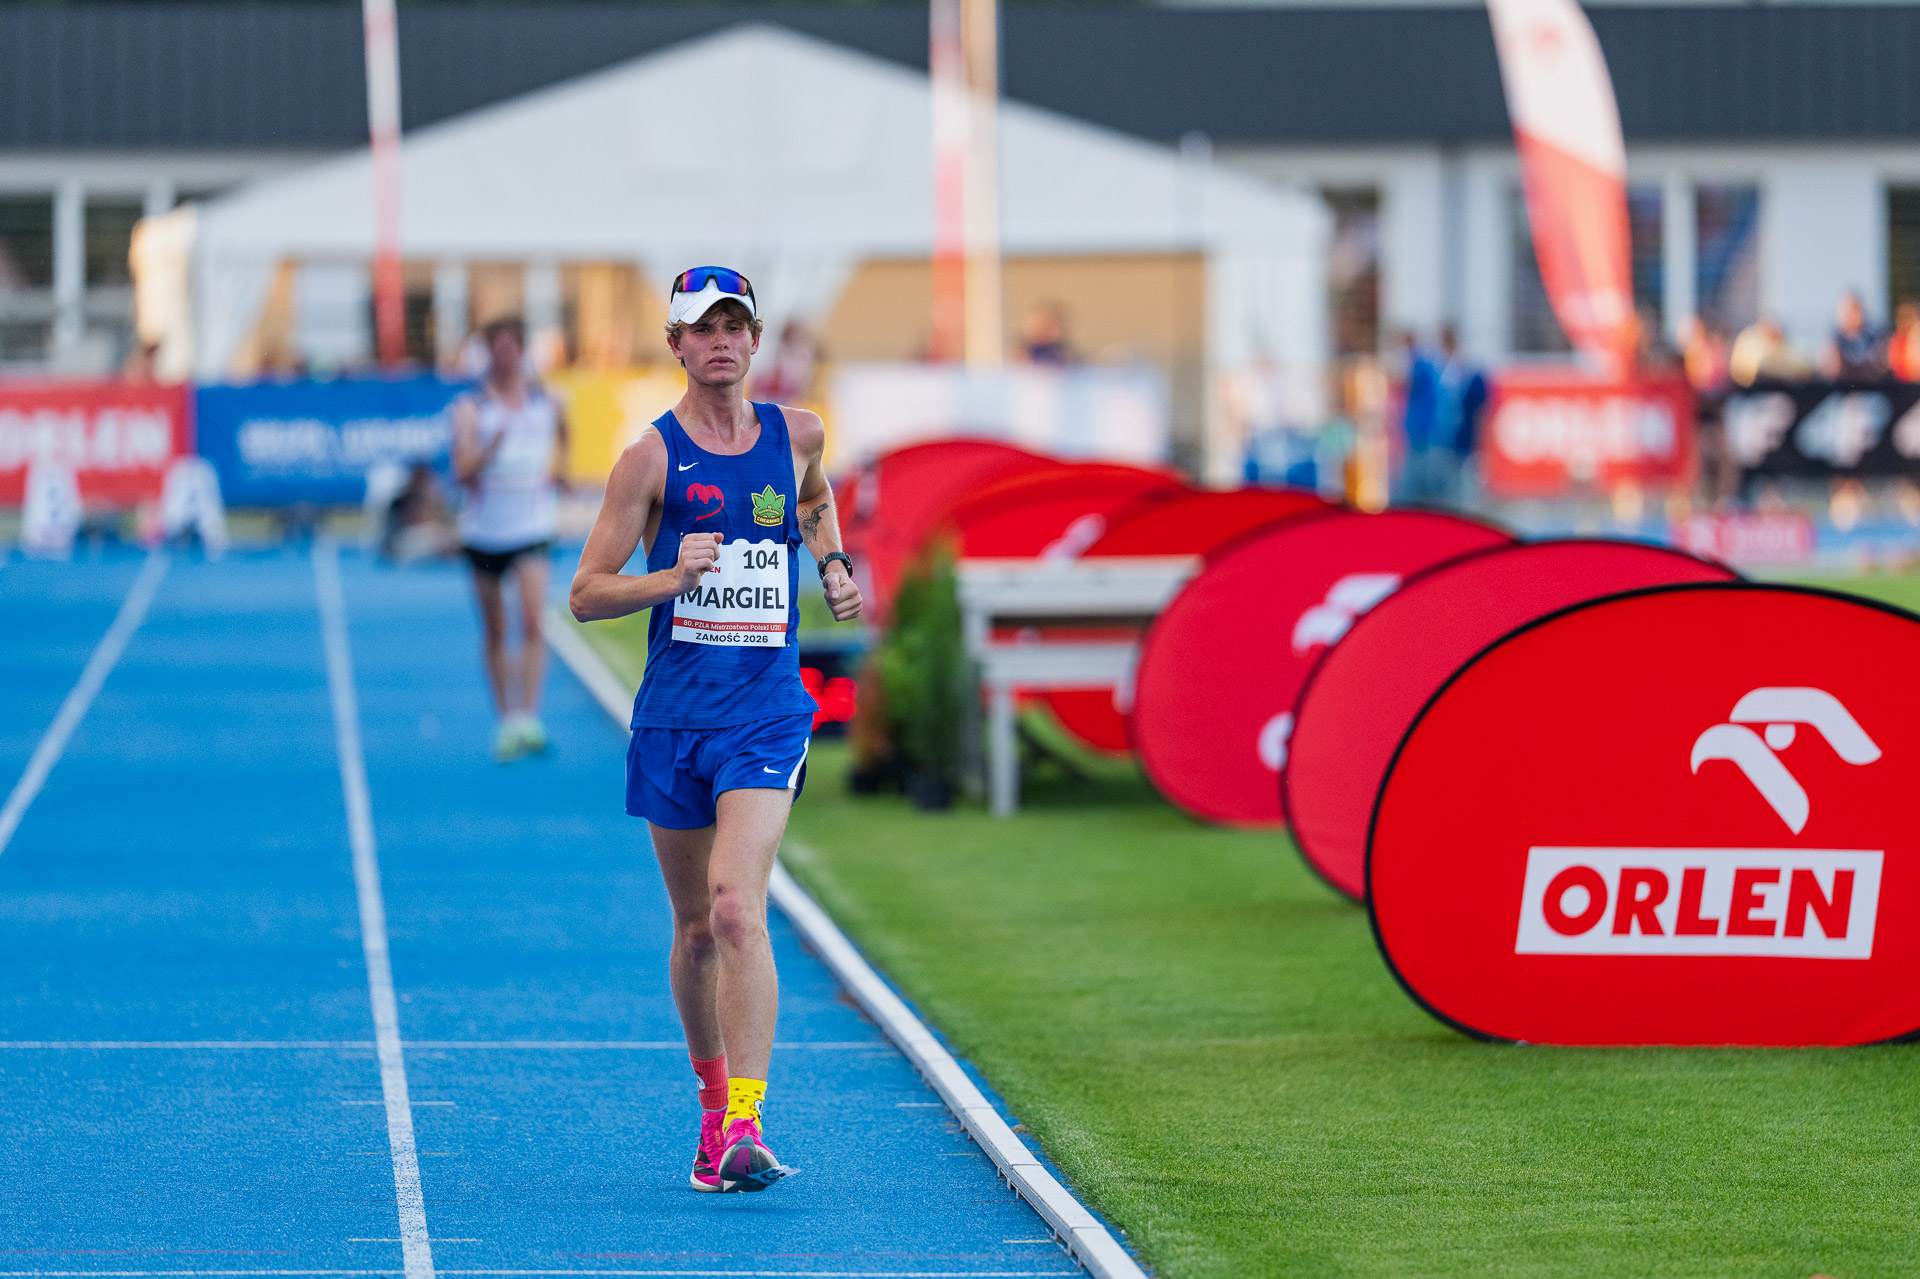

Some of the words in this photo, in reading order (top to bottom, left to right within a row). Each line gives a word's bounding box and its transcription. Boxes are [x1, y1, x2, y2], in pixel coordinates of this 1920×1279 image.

[742, 550, 779, 570] 104
[680, 586, 785, 610] MARGIEL
[683, 619, 694, 627] 80.
[695, 621, 710, 629] PZLA
[711, 623, 749, 631] Mistrzostwa
[696, 632, 741, 643] ZAMOŚĆ
[743, 634, 769, 644] 2026
[1542, 864, 1856, 940] ORLEN
